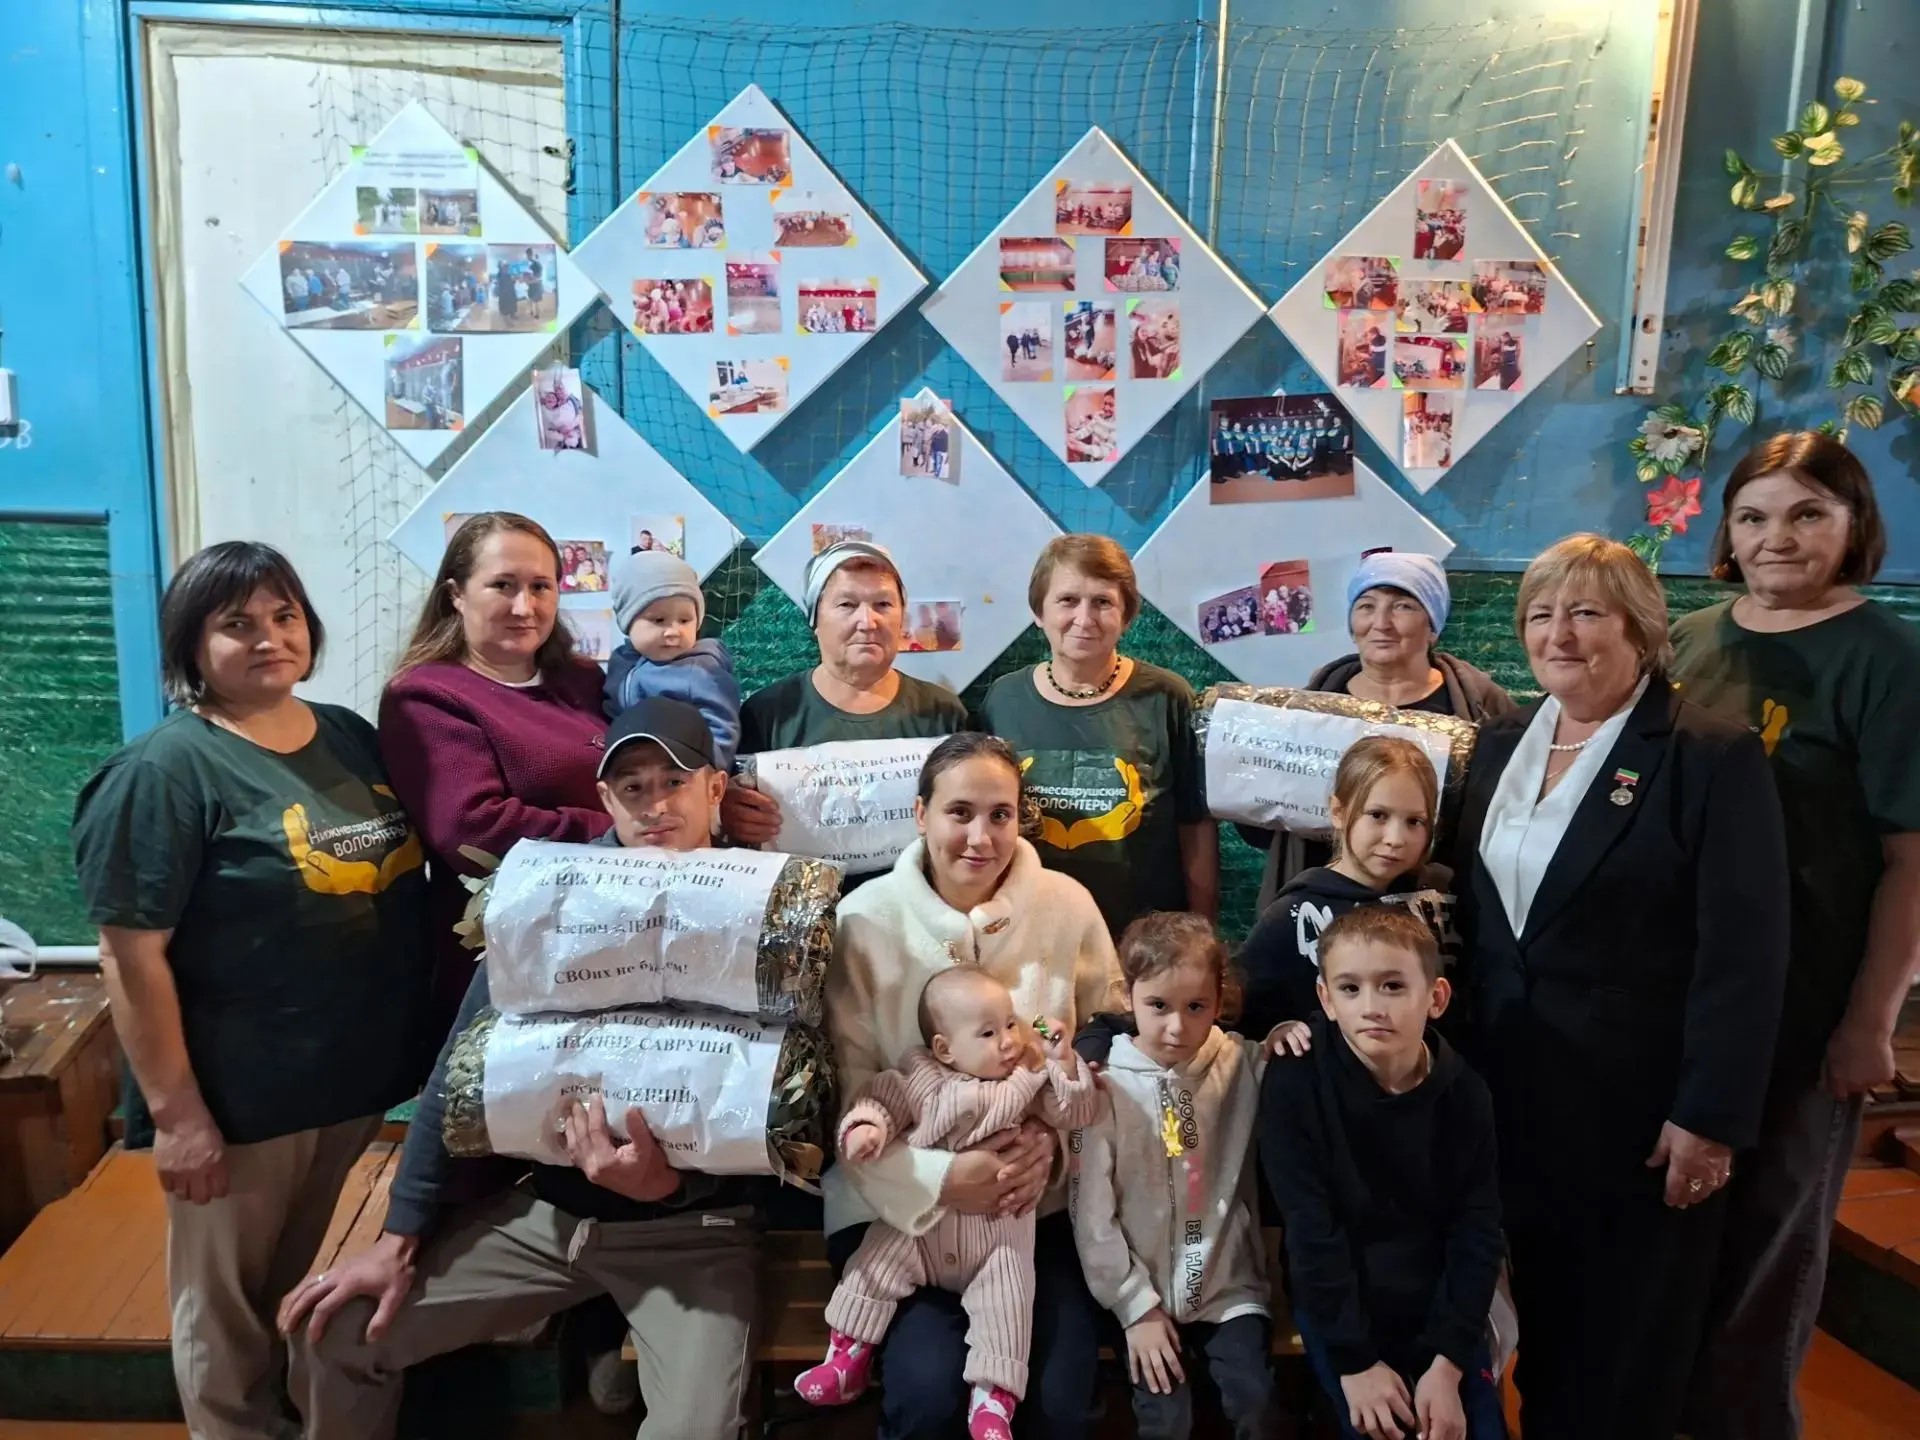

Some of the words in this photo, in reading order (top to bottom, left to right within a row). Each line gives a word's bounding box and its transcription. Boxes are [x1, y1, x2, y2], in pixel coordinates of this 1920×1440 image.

[881, 768, 921, 781] САВР
[1023, 785, 1127, 798] ижнесаврушские
[638, 1037, 733, 1055] САВРУШИ
[1178, 1089, 1199, 1149] GOOD
[1185, 1219, 1202, 1246] BE
